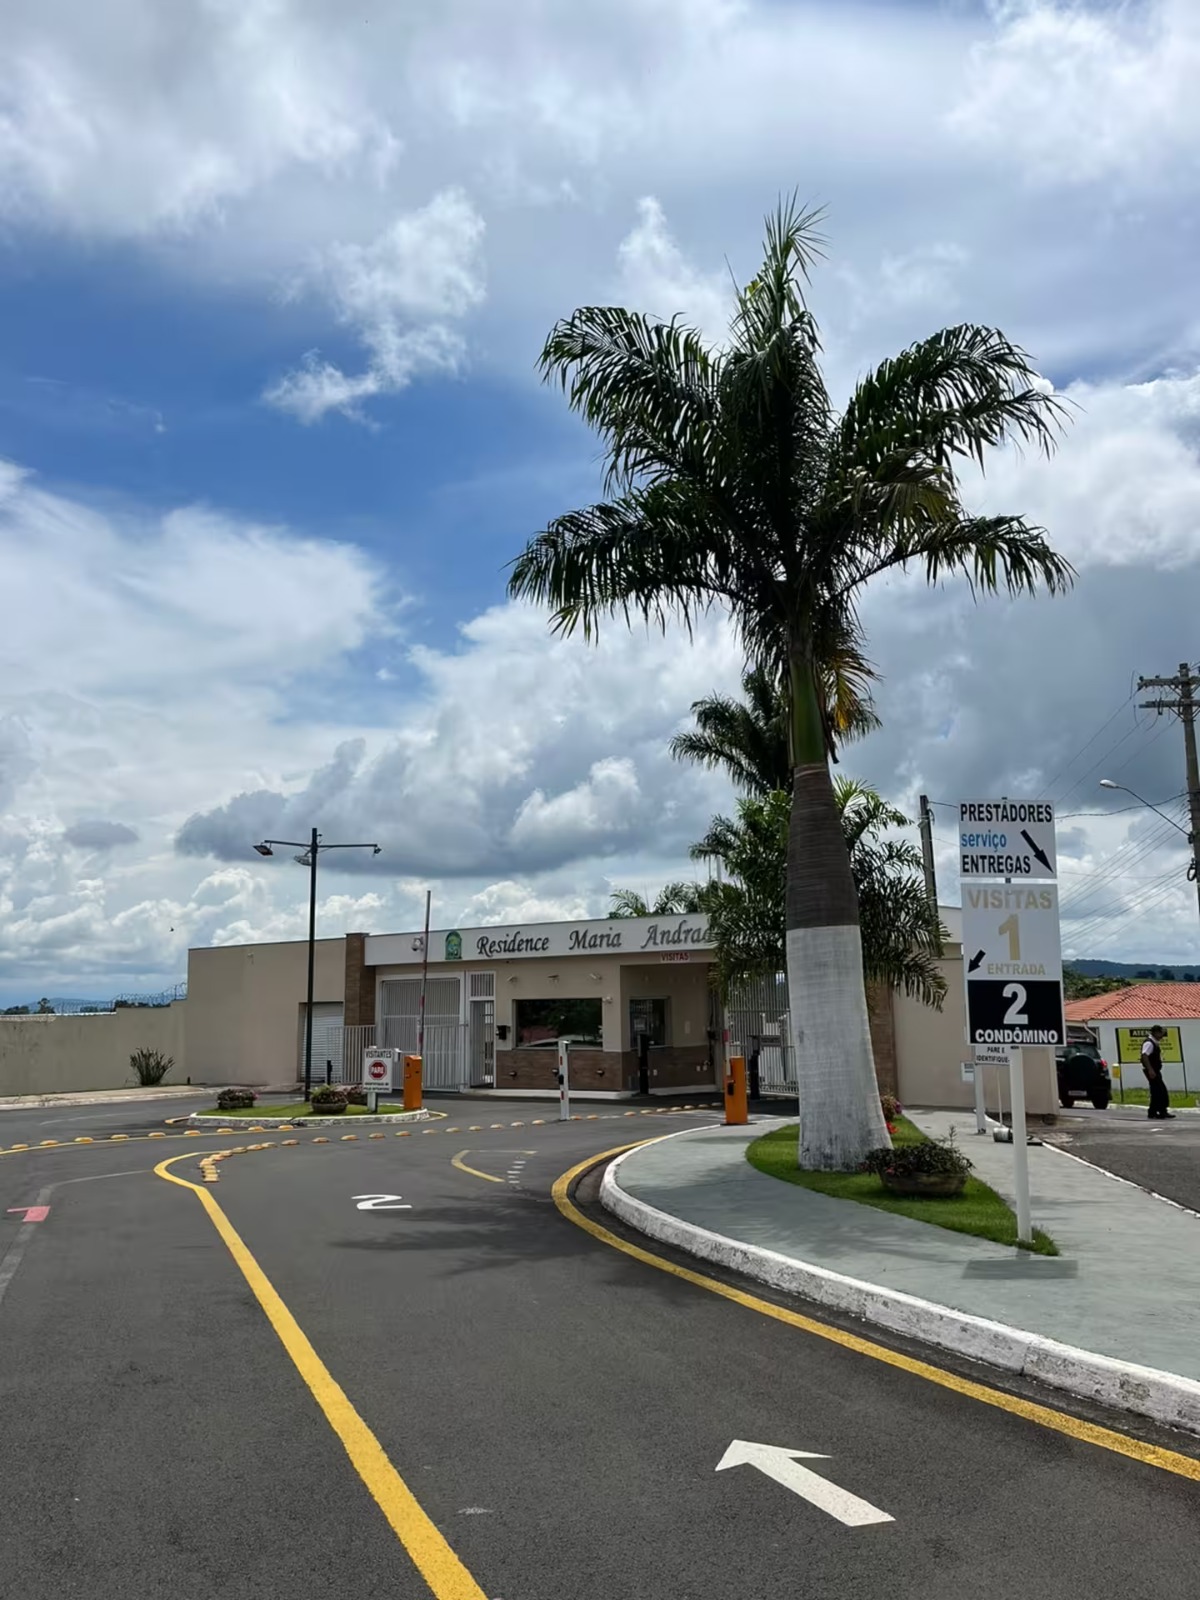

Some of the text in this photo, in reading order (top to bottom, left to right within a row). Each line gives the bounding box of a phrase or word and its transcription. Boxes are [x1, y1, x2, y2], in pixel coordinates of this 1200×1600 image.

[960, 803, 1053, 823] PRESTADORES
[961, 829, 1007, 853] serviço
[962, 854, 1031, 874] ENTREGAS
[967, 889, 1053, 910] VISITAS
[476, 931, 549, 958] Residence
[568, 927, 622, 950] Maria
[998, 913, 1021, 961] 1
[661, 952, 689, 961] VISITAS
[987, 963, 1046, 976] ENTRADA
[1002, 982, 1029, 1025] 2
[975, 1027, 1058, 1044] CONDÔMINO
[365, 1050, 392, 1058] VISITANTES
[371, 1066, 384, 1074] PARE
